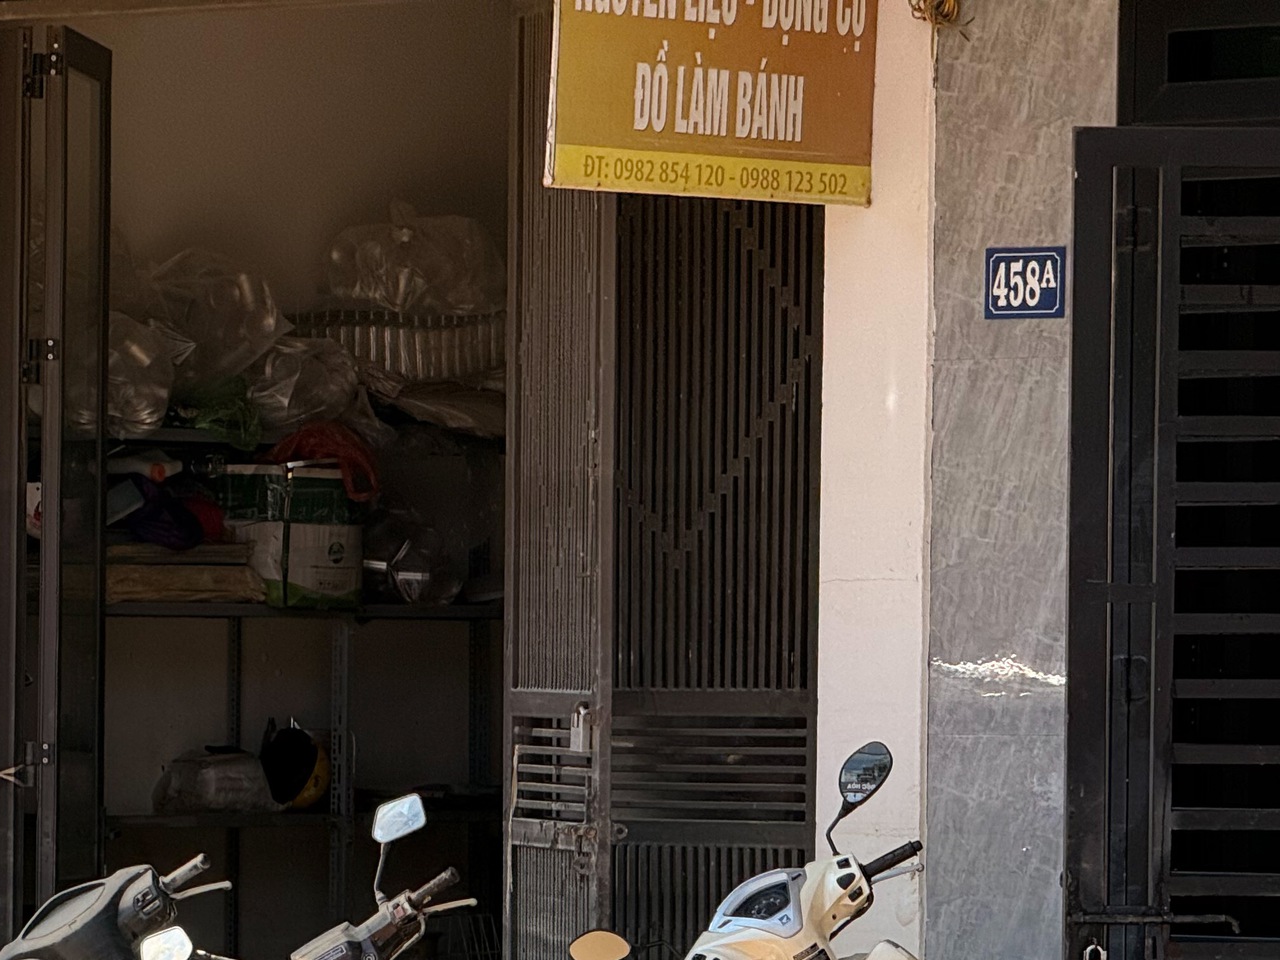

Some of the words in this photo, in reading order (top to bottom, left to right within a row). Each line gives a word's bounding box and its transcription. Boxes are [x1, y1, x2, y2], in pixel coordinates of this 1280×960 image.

[633, 39, 669, 132] ĐỒ
[674, 51, 730, 137] LÀM
[735, 57, 804, 142] BÁNH
[583, 154, 609, 179] ĐT:
[613, 157, 655, 182] 0982
[659, 160, 690, 185] 854
[695, 163, 725, 187] 120
[740, 166, 780, 191] 0988
[785, 170, 814, 193] 123
[818, 172, 848, 195] 502
[992, 259, 1057, 307] 458A
